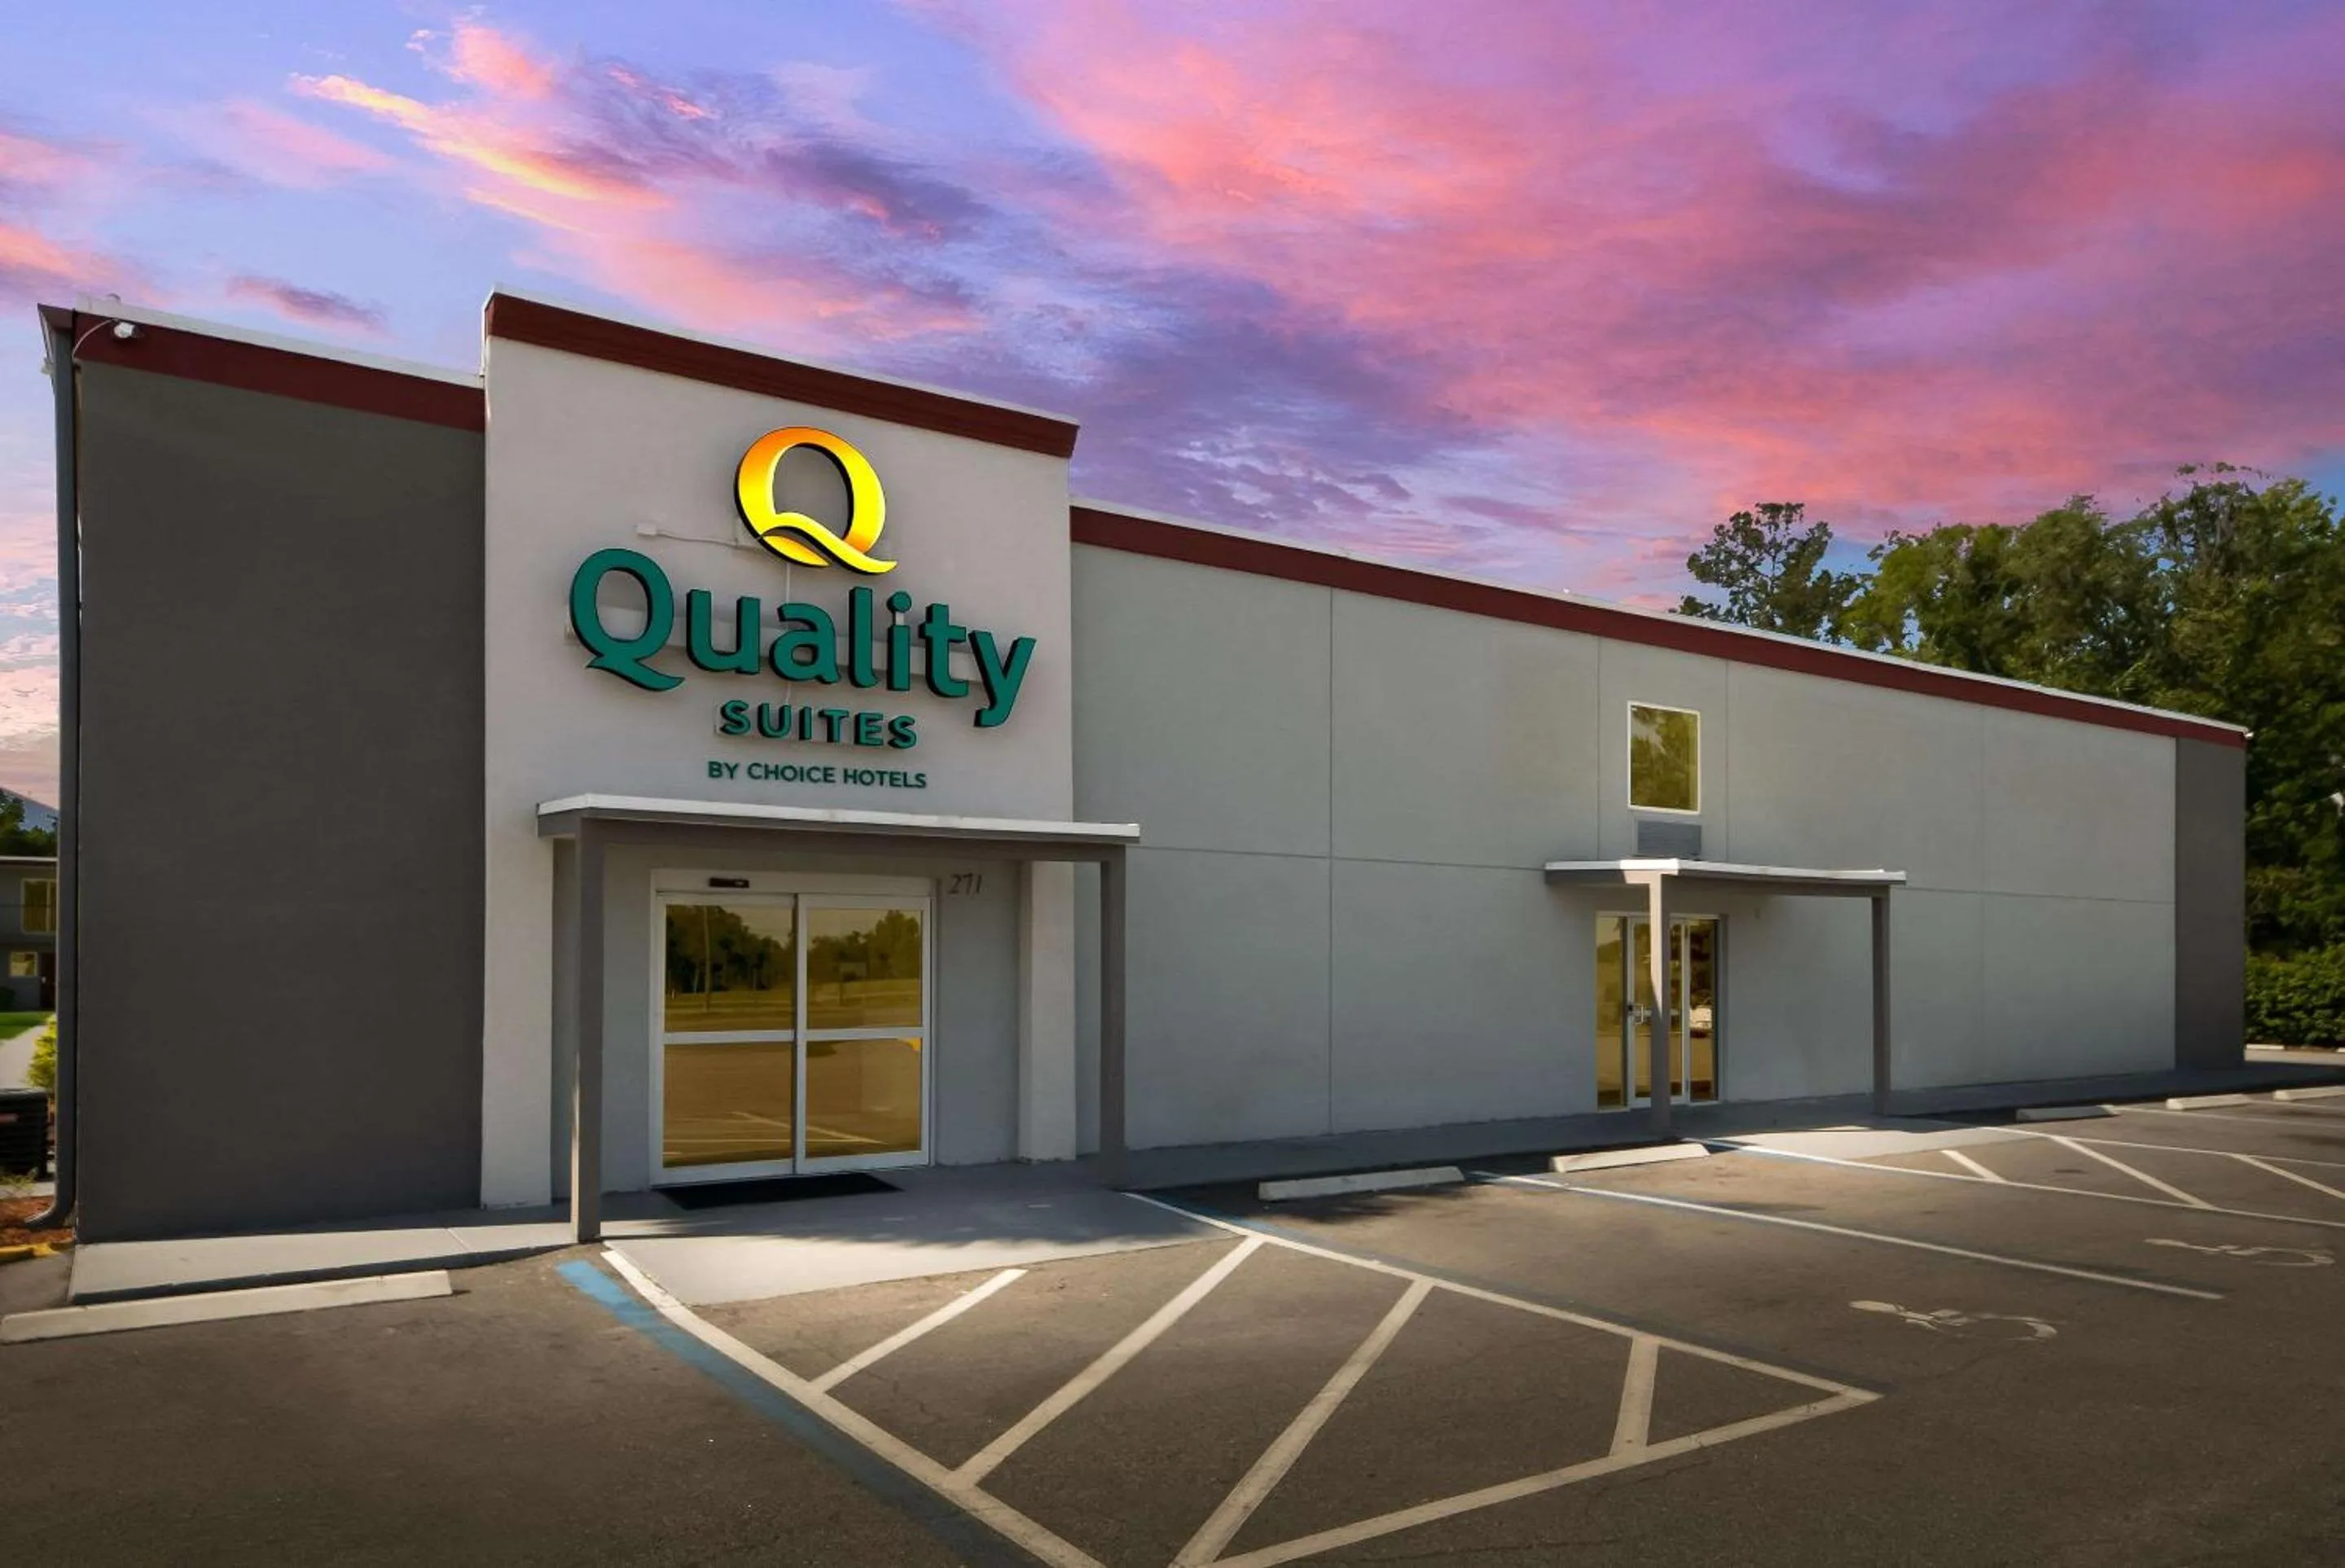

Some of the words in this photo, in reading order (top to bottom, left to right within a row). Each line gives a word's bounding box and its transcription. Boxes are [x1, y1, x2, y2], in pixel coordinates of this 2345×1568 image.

[736, 426, 898, 573] Q
[570, 547, 1037, 727] Quality
[720, 700, 917, 749] SUITES
[708, 761, 739, 780] BY
[747, 762, 836, 784] CHOICE
[843, 767, 927, 788] HOTELS
[948, 872, 982, 895] 271
